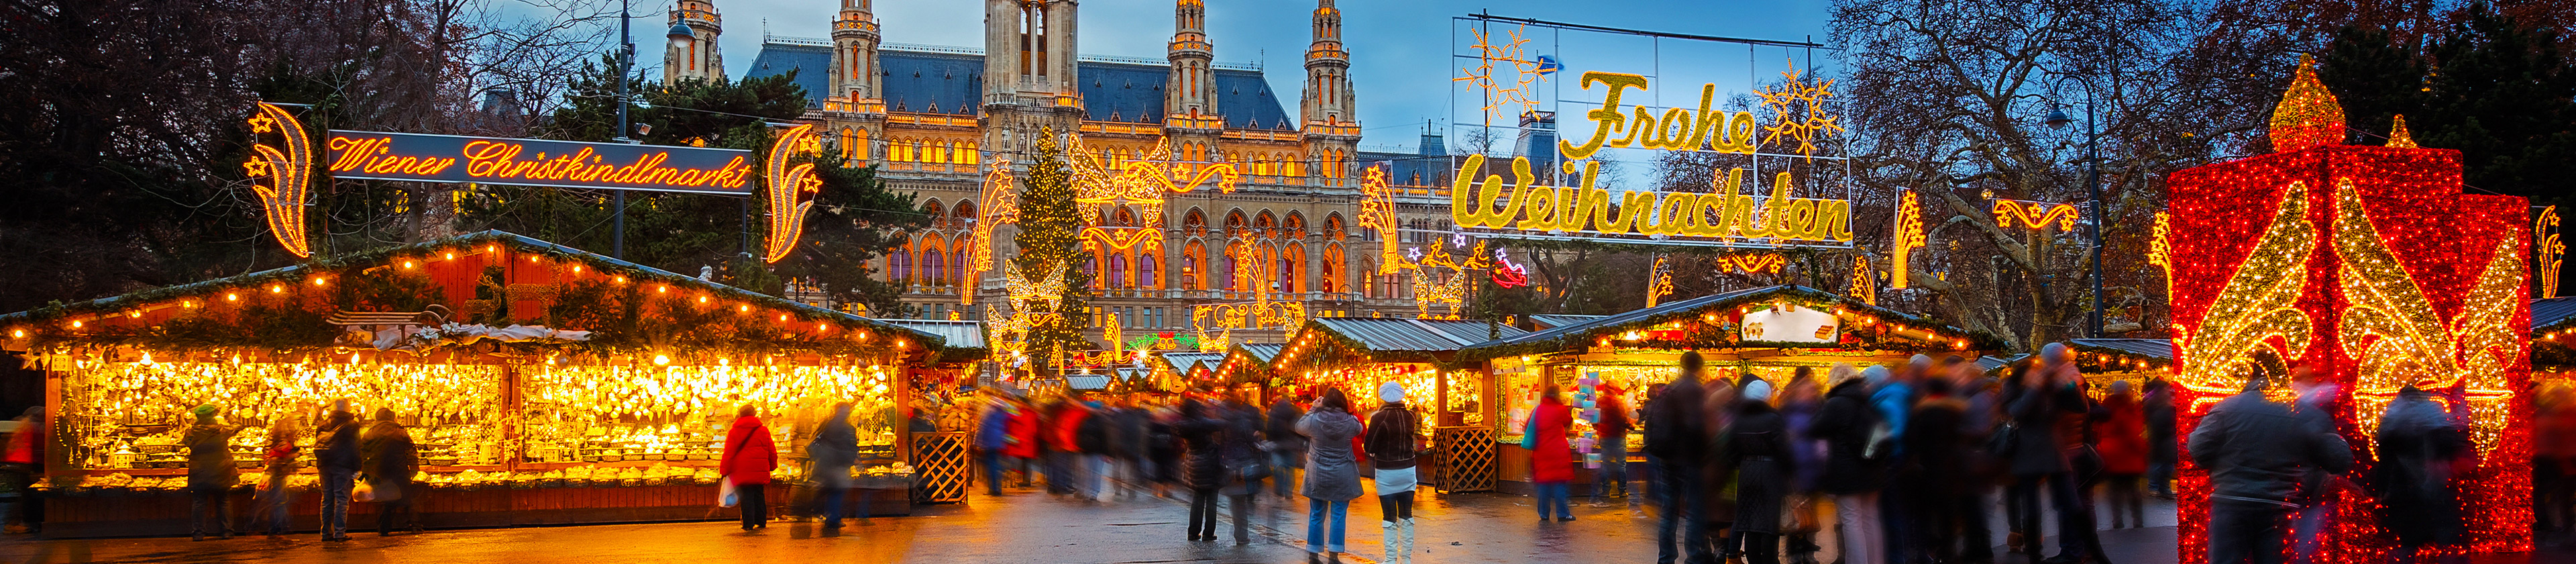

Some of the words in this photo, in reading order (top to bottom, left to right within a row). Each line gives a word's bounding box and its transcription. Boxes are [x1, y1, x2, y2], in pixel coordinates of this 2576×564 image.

[1559, 70, 1756, 160] Frohe
[329, 136, 455, 175] Wiener
[463, 140, 752, 189] Christkindlmarkt
[1452, 153, 1854, 242] Weihnachten
